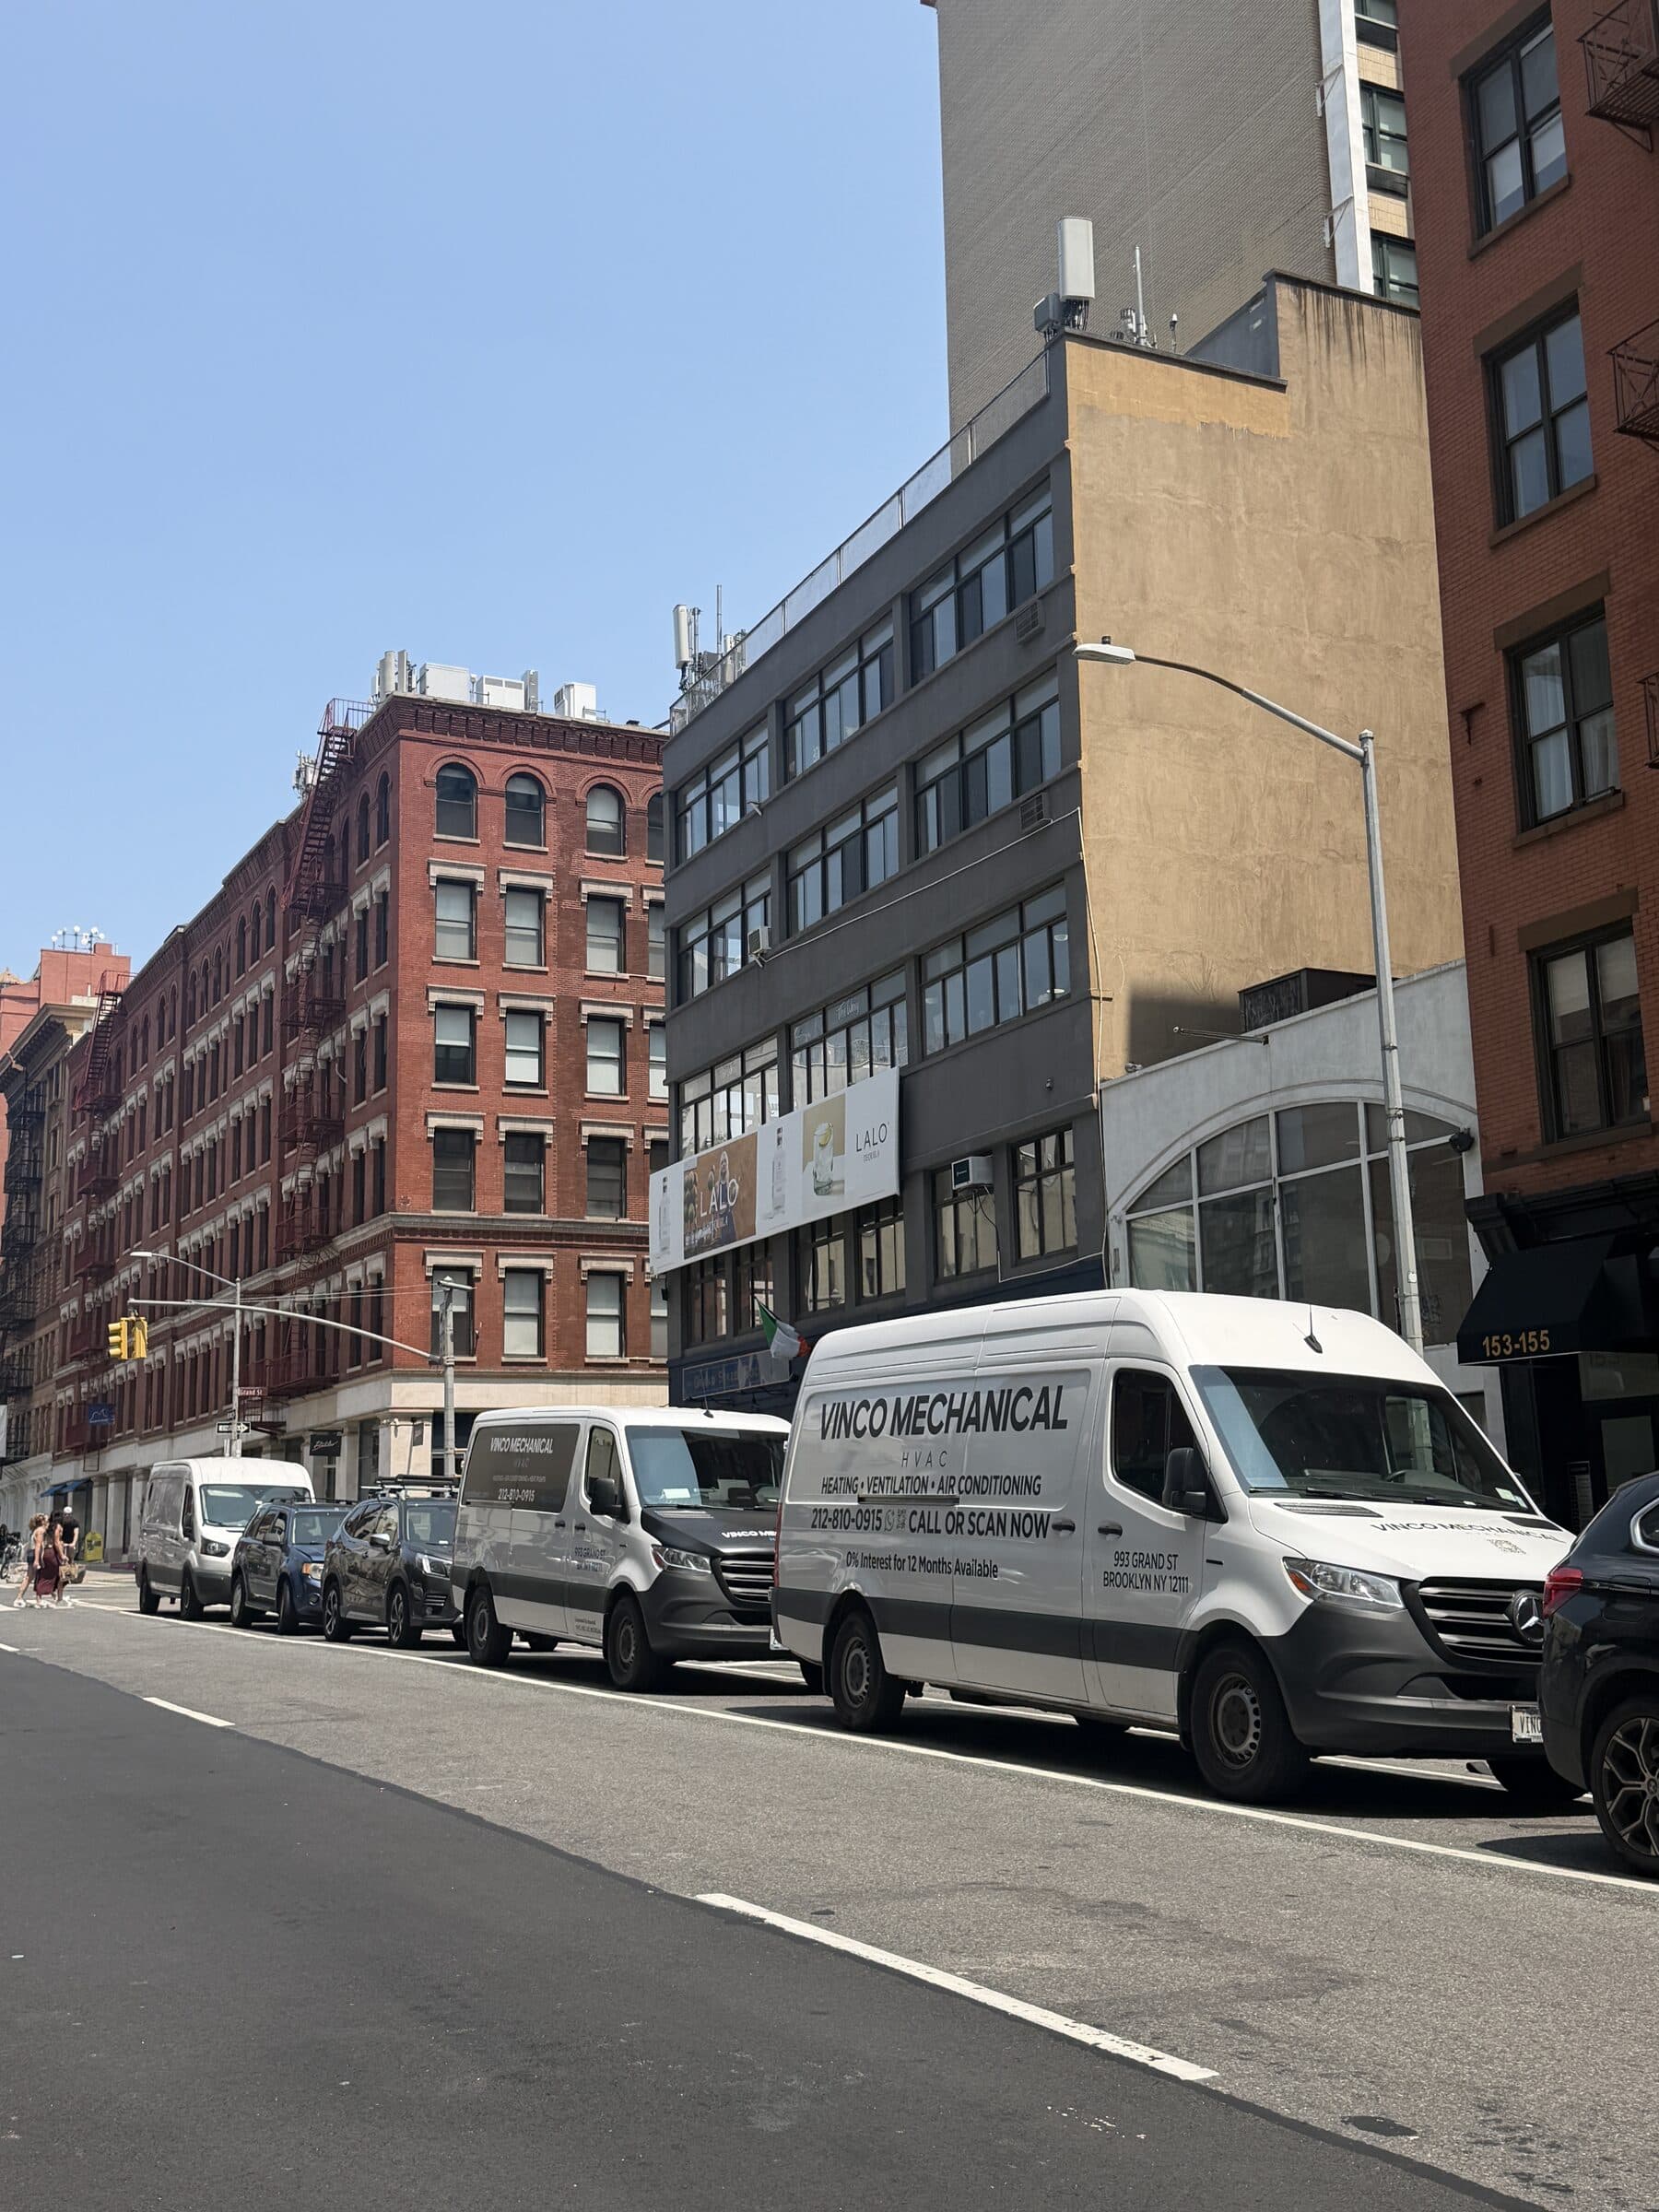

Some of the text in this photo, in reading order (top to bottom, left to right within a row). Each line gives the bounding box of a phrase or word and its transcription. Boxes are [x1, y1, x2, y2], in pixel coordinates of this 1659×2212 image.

[856, 1124, 887, 1152] LALO
[700, 1178, 739, 1217] LALO
[1482, 1330, 1550, 1358] 153-155
[821, 1385, 1068, 1440] VINCO MECHANICAL
[490, 1438, 553, 1453] VINCO MECHANICAL
[498, 1488, 535, 1502] 212-810-0915
[821, 1476, 1041, 1496] HEATING VENTILATION AIR CONDITIONING
[722, 1530, 758, 1538] VINCO
[811, 1508, 1051, 1539] 212-810-0915 CALL OR SCAN NOW
[1371, 1523, 1566, 1544] VINCO MECHANICAL
[846, 1551, 998, 1579] 0% Interest for 12 Months Available
[1113, 1550, 1179, 1571] 993 GRAND ST
[1103, 1571, 1189, 1593] BROOKLYN NY 12111
